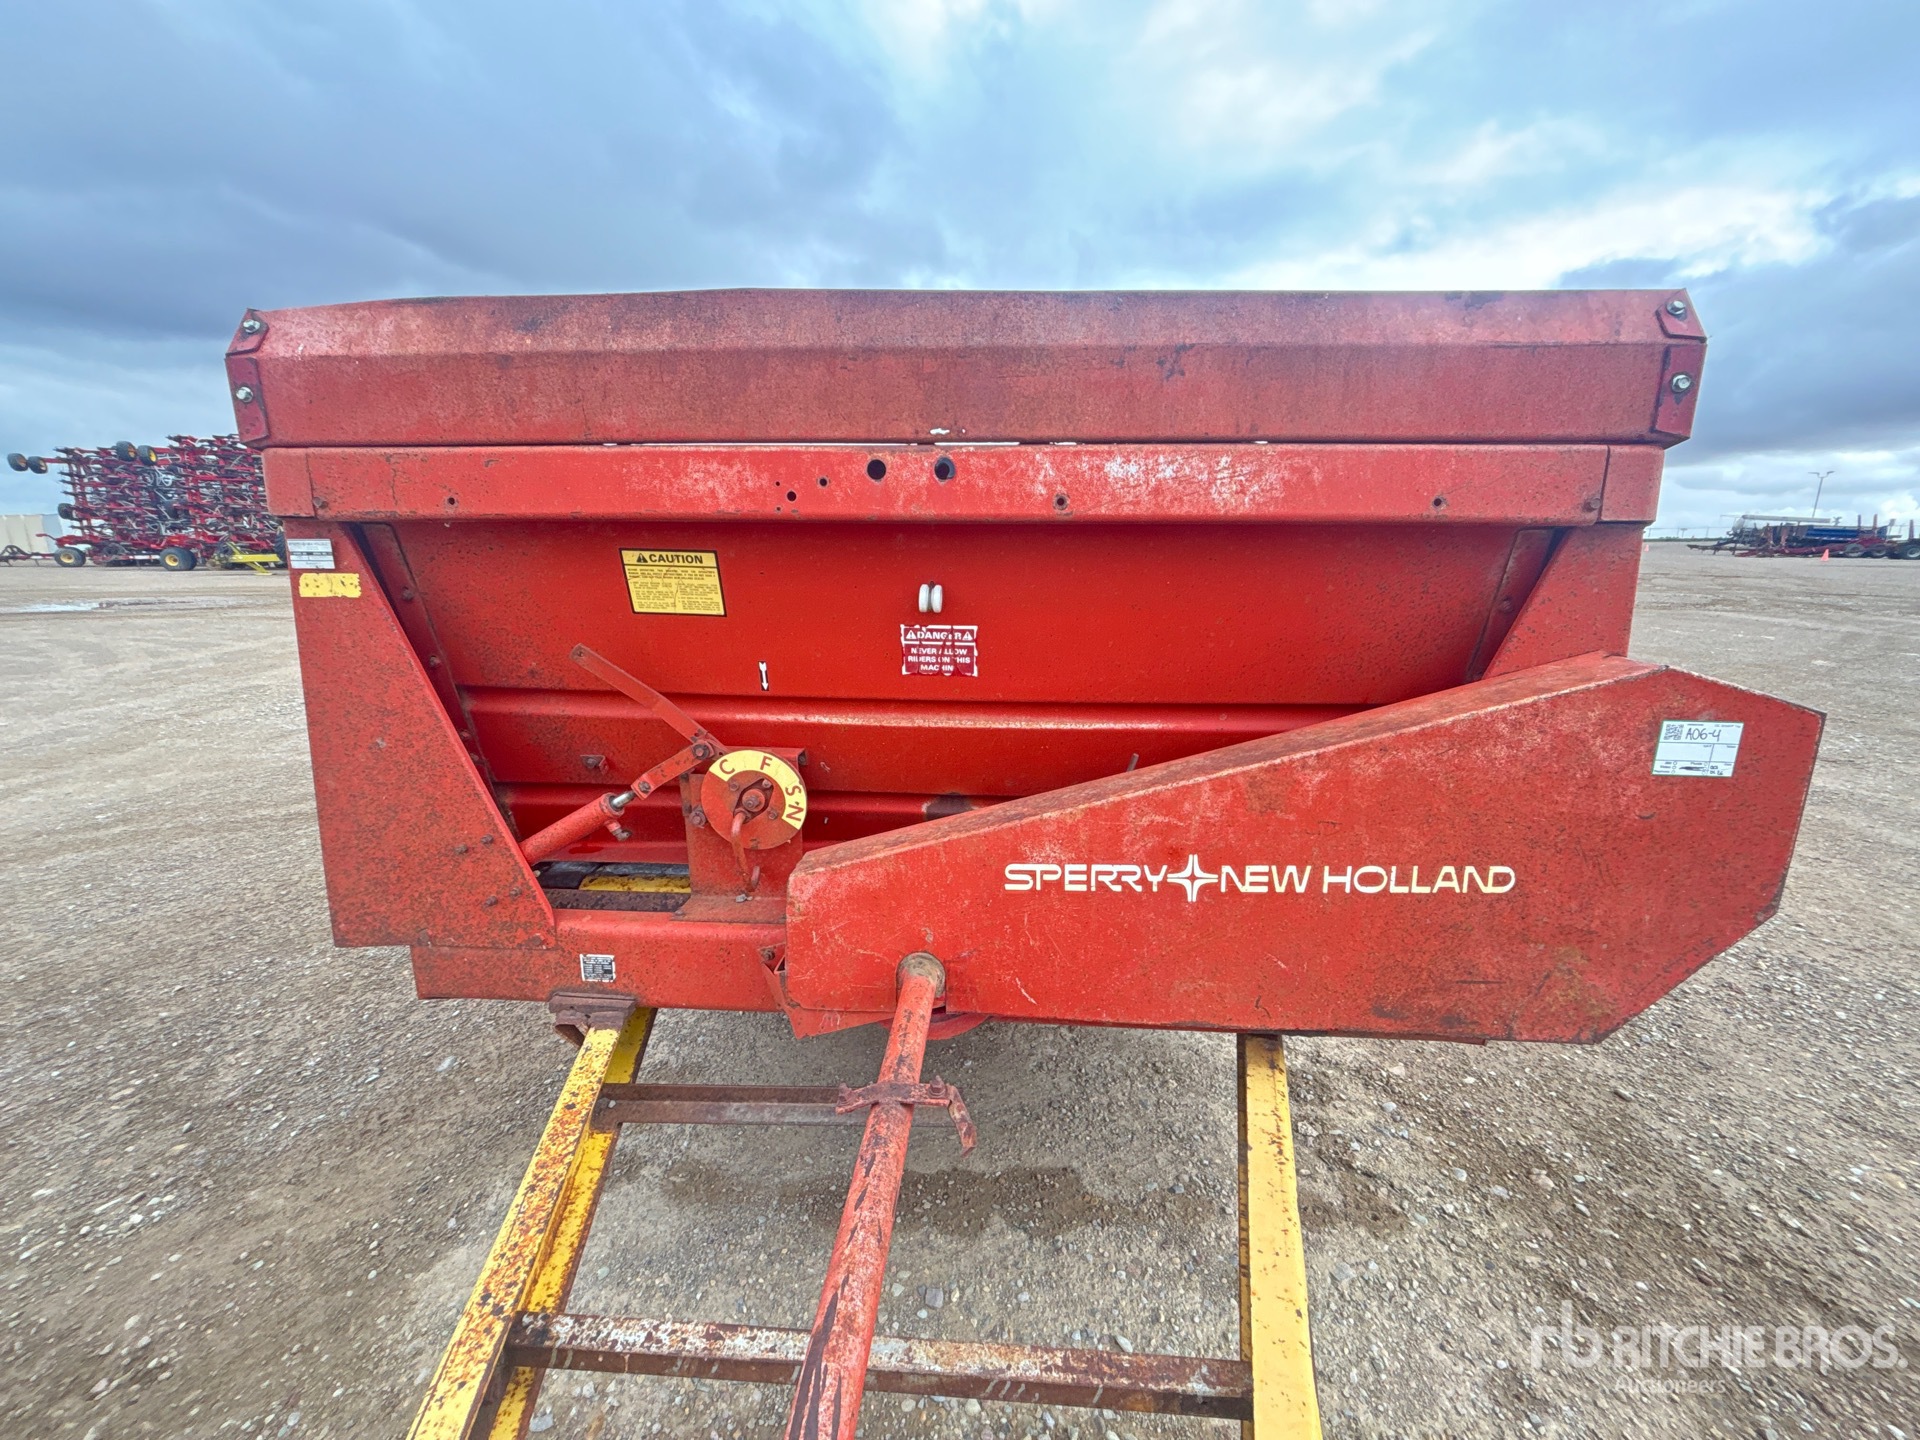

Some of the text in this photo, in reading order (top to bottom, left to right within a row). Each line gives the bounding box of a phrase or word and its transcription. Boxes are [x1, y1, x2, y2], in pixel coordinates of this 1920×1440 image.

[649, 554, 703, 564] CAUTION
[954, 656, 971, 664] HIS
[1685, 727, 1722, 742] A06-4
[719, 758, 736, 775] C
[759, 755, 773, 771] F
[785, 785, 802, 797] S
[1004, 863, 1516, 894] SPERRY NEW HOLLAND
